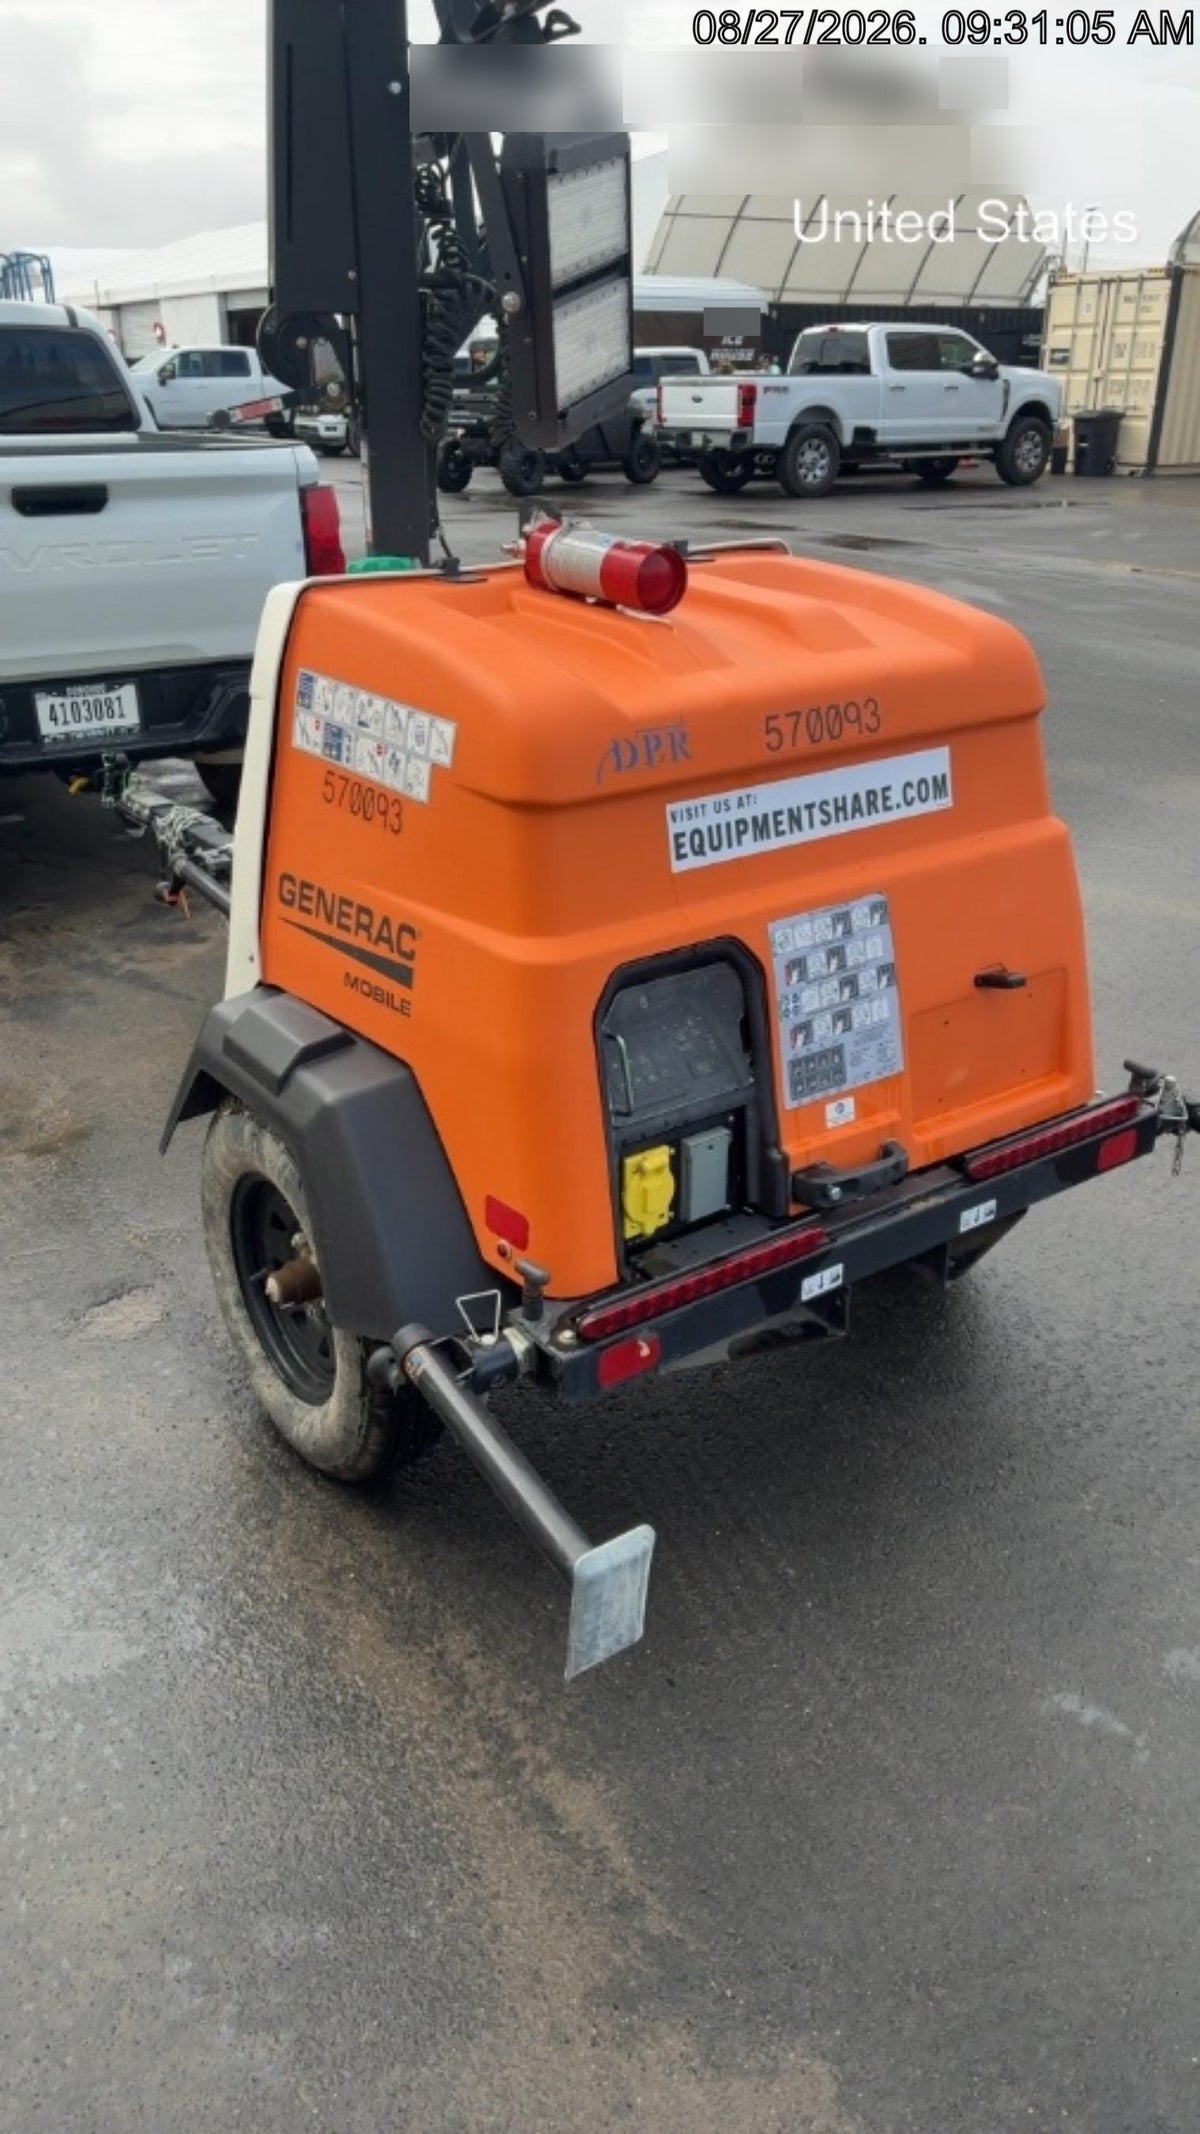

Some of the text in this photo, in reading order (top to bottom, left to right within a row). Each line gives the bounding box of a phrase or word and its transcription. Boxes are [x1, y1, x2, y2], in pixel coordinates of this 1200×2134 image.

[49, 695, 126, 726] 4103081
[763, 698, 881, 753] 570093
[607, 723, 694, 773] DPR
[322, 769, 403, 835] 570093
[670, 793, 758, 824] VISIT US AT:
[673, 773, 950, 862] EQUIPMENTSHARE.COM
[277, 872, 417, 962] GENERAC
[343, 971, 412, 1018] MOBILE
